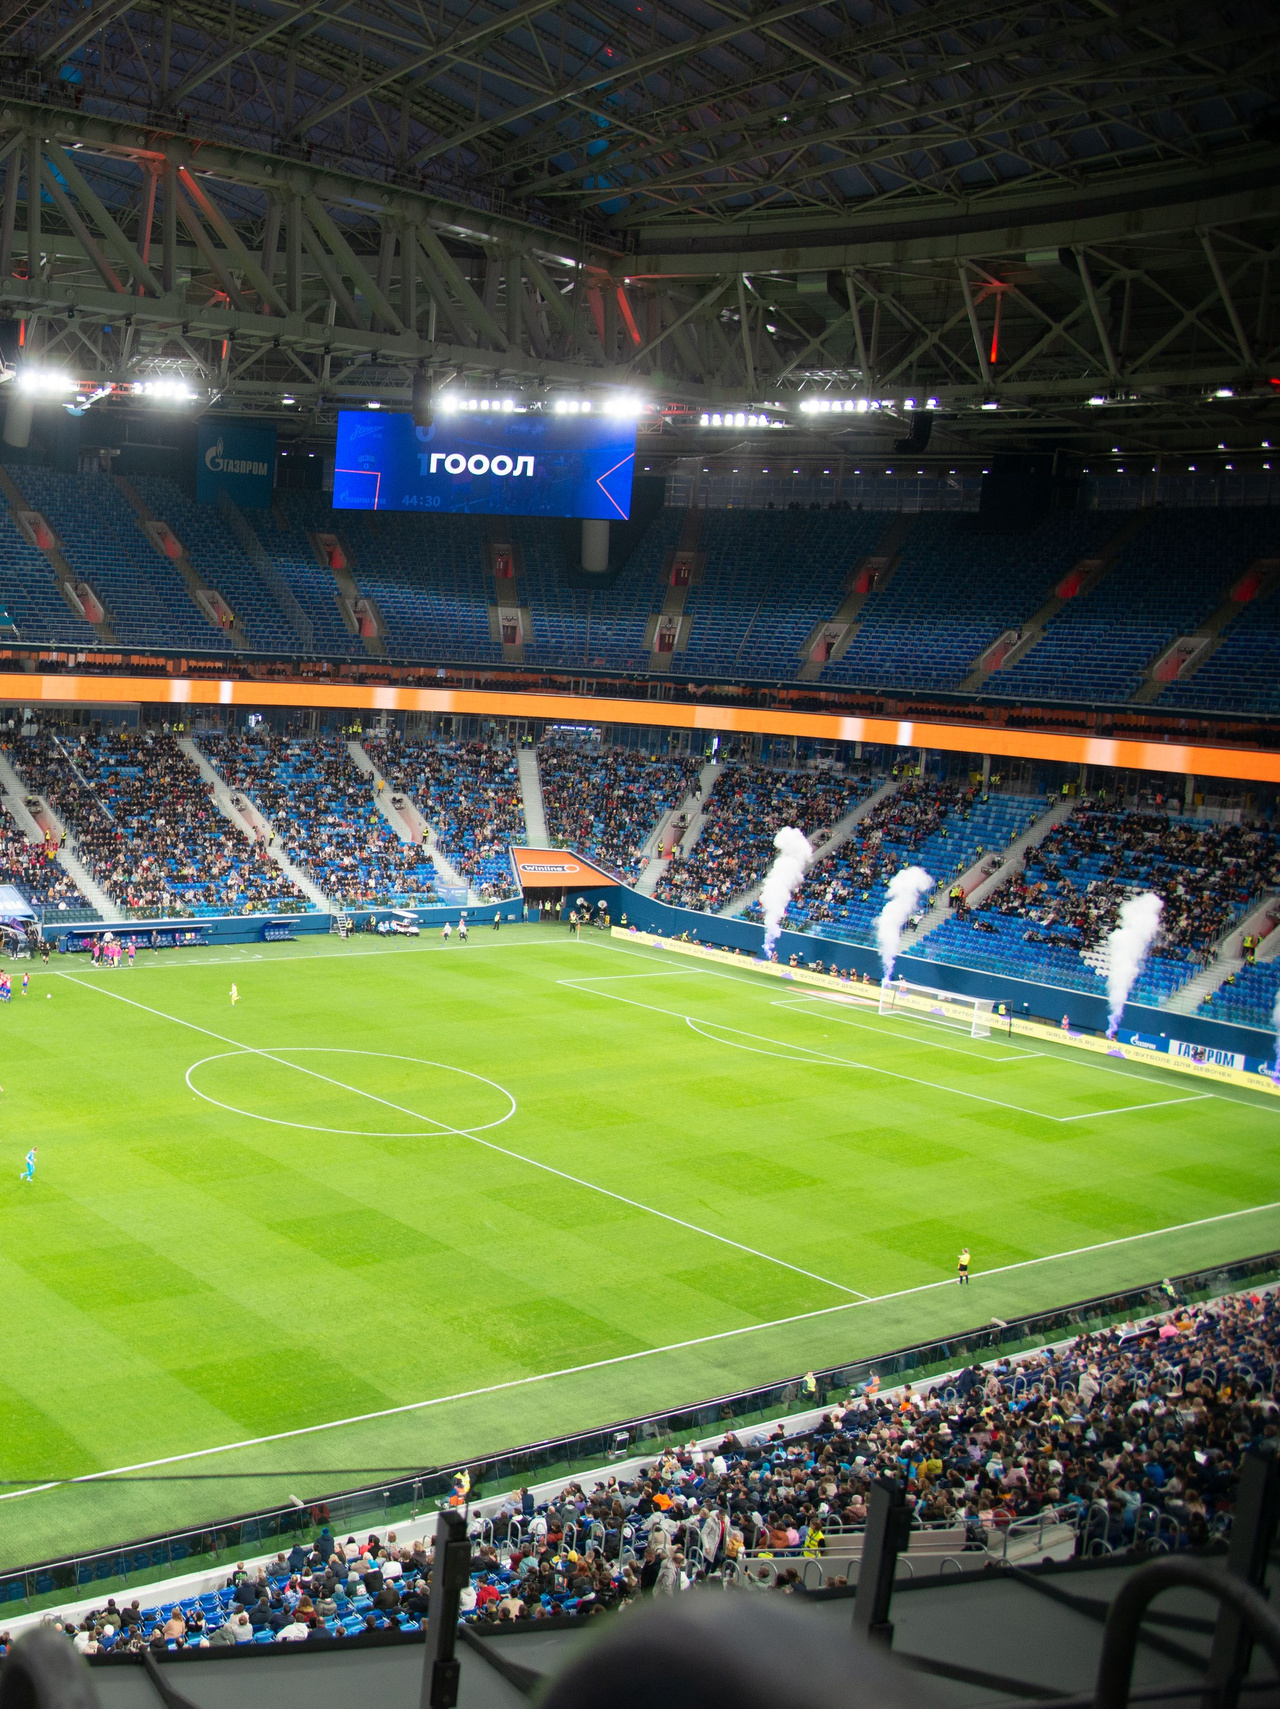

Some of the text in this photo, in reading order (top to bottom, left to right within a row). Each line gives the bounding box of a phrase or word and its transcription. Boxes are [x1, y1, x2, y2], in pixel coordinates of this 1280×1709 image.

[224, 459, 268, 476] ГАЗПРОМ
[430, 453, 535, 477] ГОООЛ
[402, 495, 441, 507] 44:30
[524, 865, 563, 873] Winline
